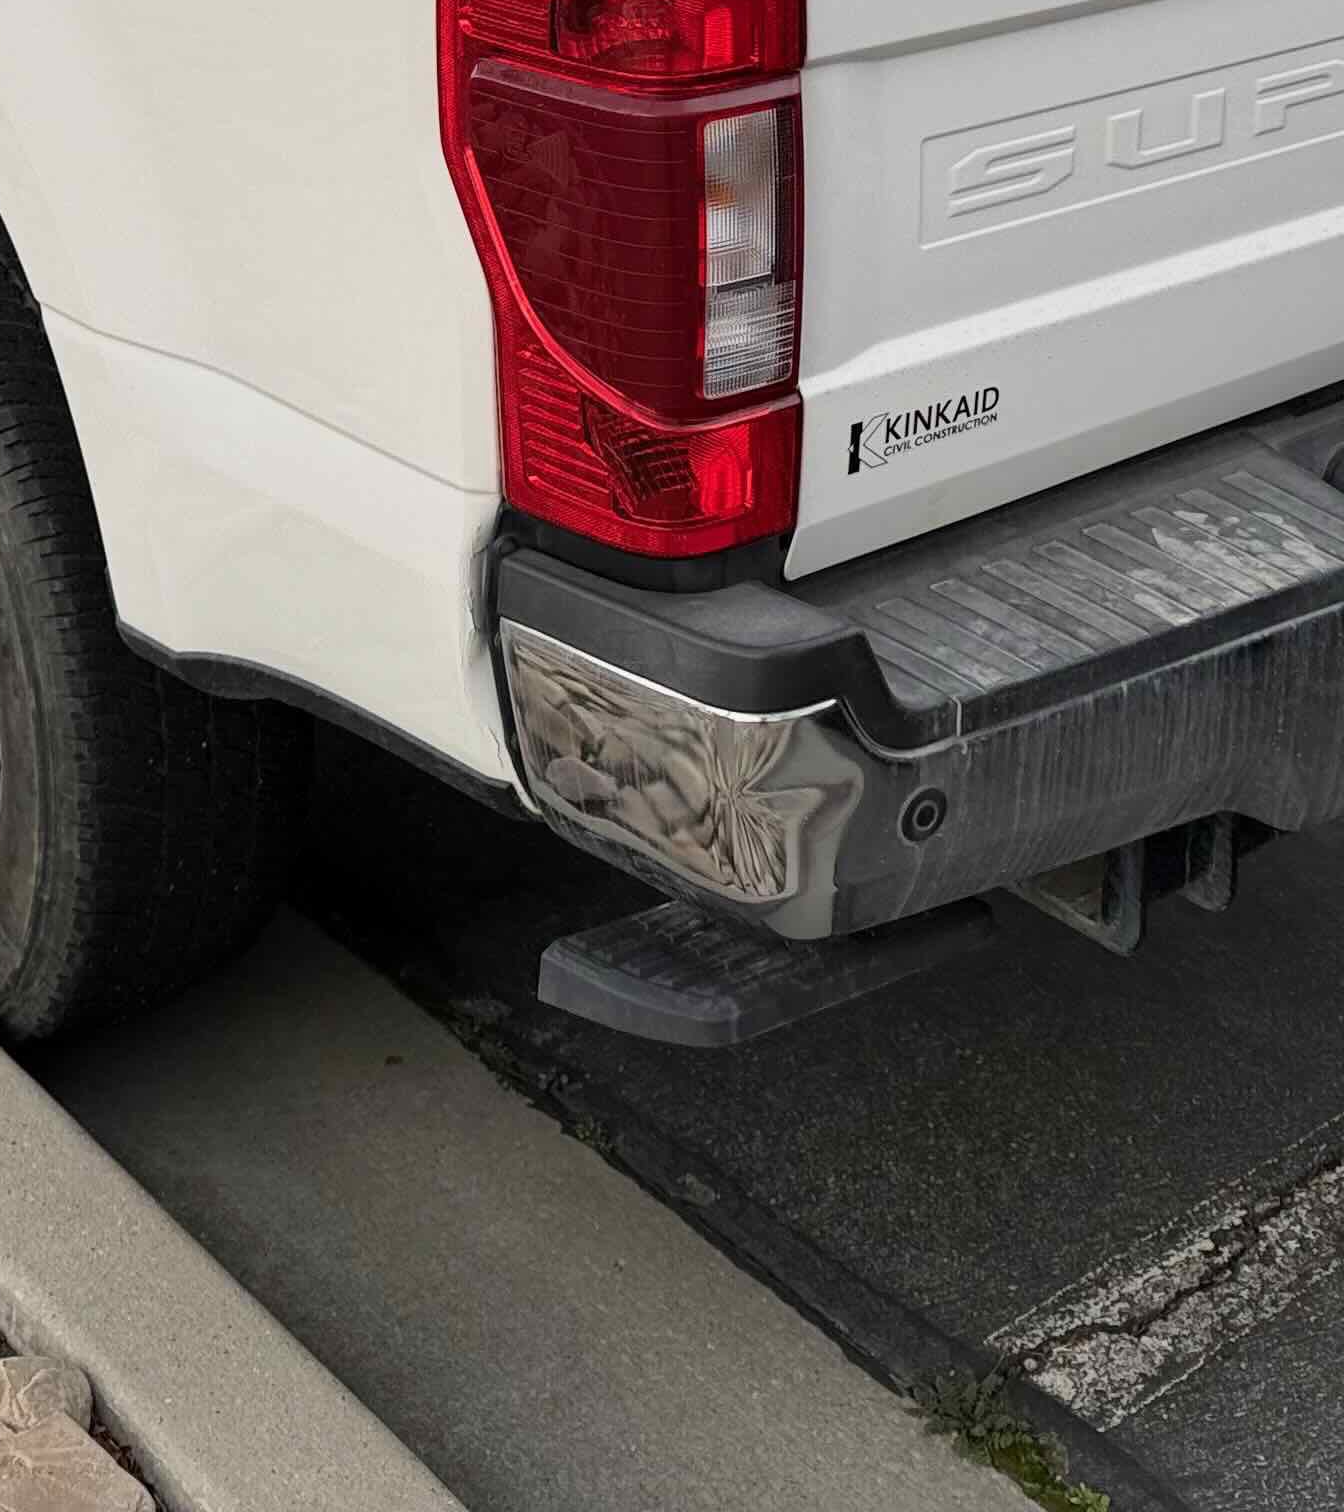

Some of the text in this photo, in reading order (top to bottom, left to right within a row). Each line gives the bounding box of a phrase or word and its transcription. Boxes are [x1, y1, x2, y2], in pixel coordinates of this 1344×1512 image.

[883, 412, 998, 456] CIVIL CONSTRUCTION
[885, 386, 1000, 443] KINKAID
